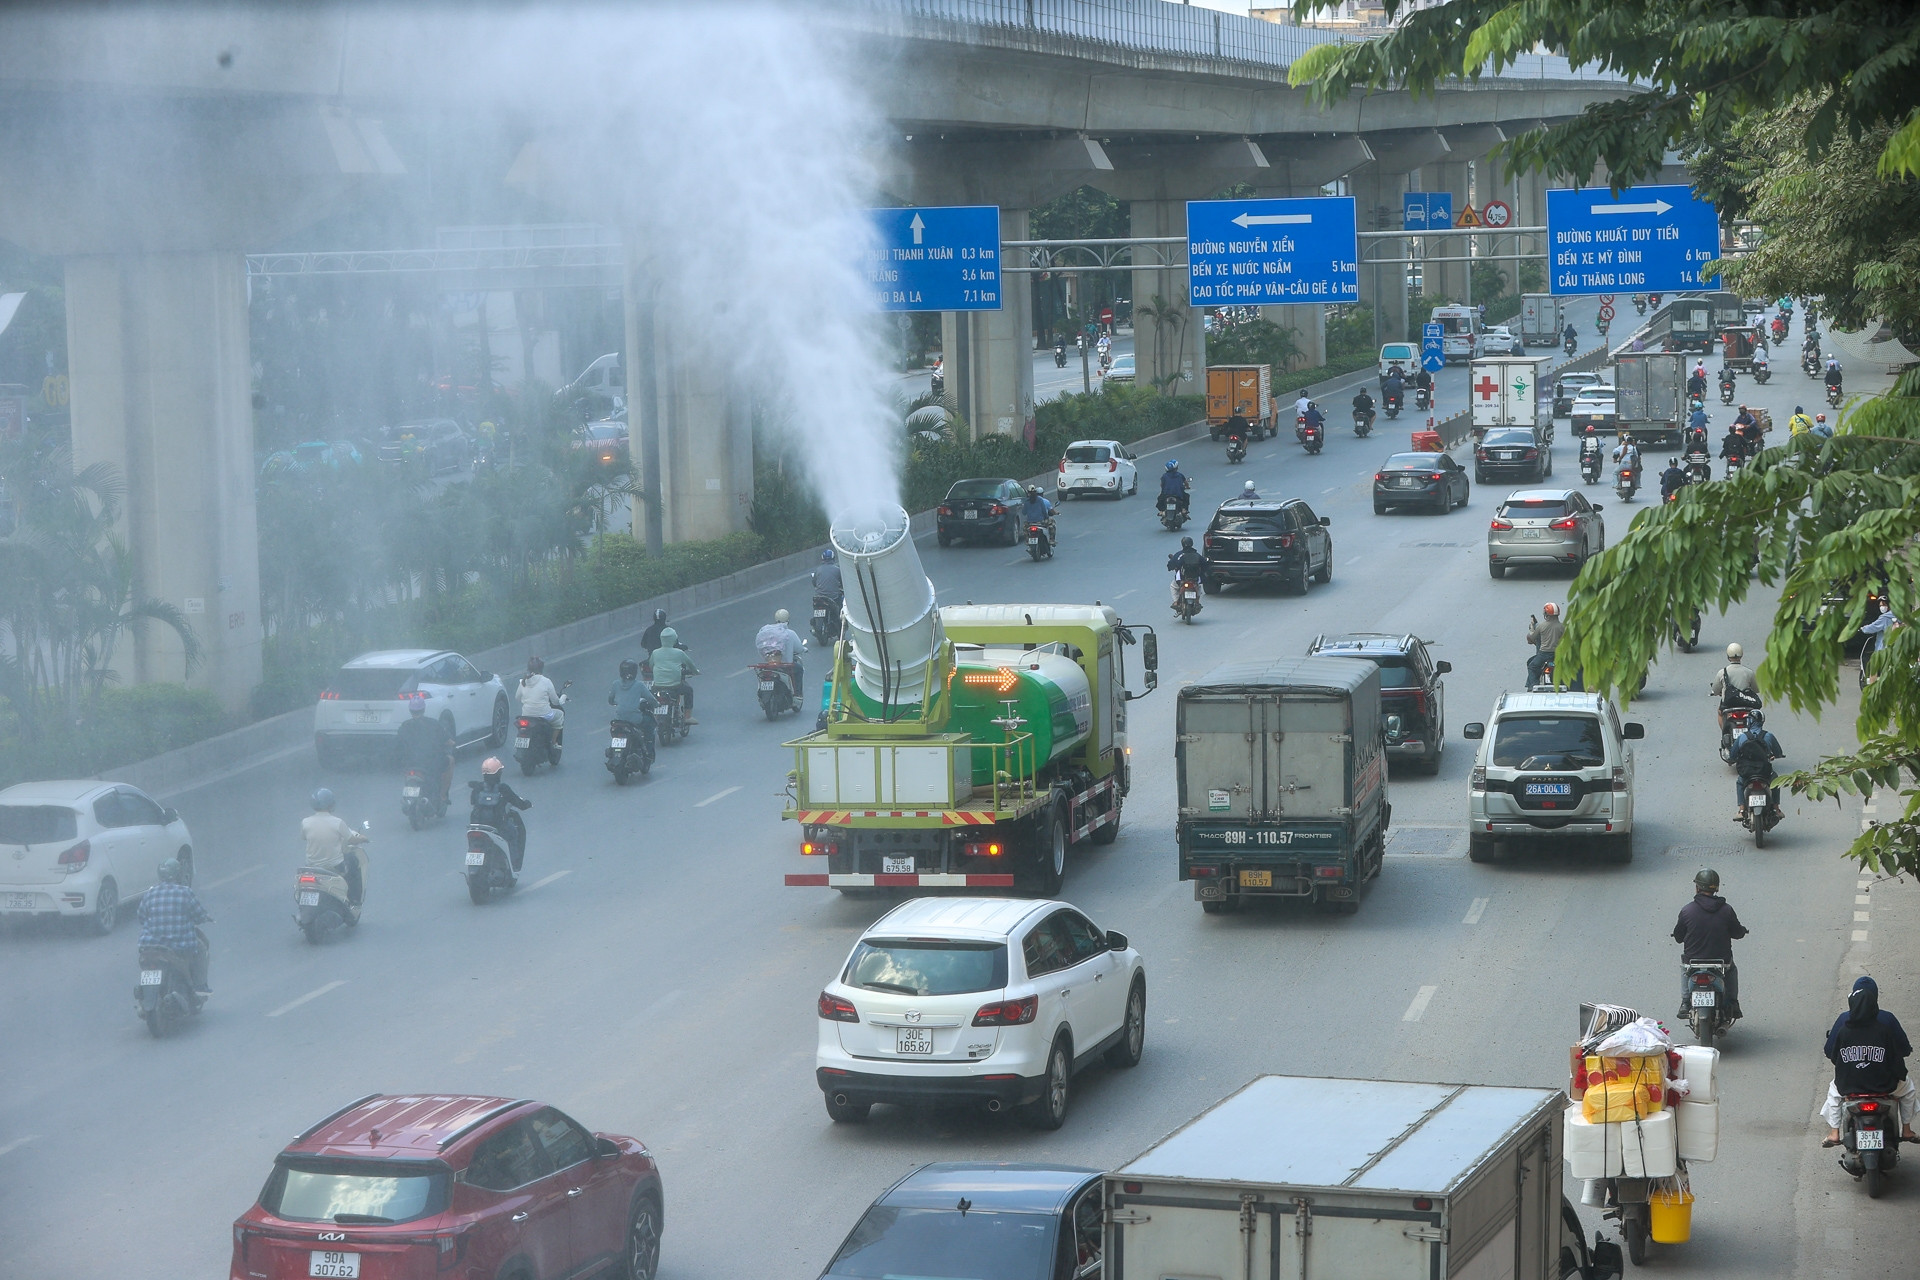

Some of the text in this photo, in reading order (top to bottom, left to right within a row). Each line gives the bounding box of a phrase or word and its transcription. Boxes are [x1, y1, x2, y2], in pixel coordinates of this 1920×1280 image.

[1557, 224, 1679, 243] ĐƯỜNG KHUẤT DUY TIẾN
[1191, 235, 1295, 254] ĐƯỜNG NGUYỄN XIỂN
[893, 248, 924, 260] THANH
[928, 246, 953, 260] XUÂN
[980, 248, 994, 259] km
[1558, 248, 1712, 265] BẾN XE MỸ ĐÌNH 6 km
[980, 268, 995, 280] km
[1192, 258, 1356, 276] BẾN XE NƯỚC NGẦM 5 km
[1558, 271, 1578, 287] CẦU
[1582, 271, 1615, 286] THĂNG
[1618, 272, 1645, 285] LONG
[1680, 271, 1693, 283] 14
[1193, 285, 1212, 297] CAO
[1215, 281, 1234, 297] TỐC
[1237, 280, 1262, 296] PHÁP
[1312, 280, 1328, 294] GIẼ
[1332, 282, 1338, 294] 6
[1342, 281, 1357, 294] km
[893, 291, 906, 303] BA
[910, 291, 922, 302] LA
[981, 290, 996, 302] km
[1225, 832, 1246, 844] 89H
[1257, 832, 1293, 844] 110.57
[905, 1029, 924, 1040] 30E
[899, 1041, 931, 1053] 165.87
[1840, 1046, 1886, 1063] SCRIPTED
[324, 1252, 345, 1264] 90A
[315, 1264, 353, 1277] 307.62
